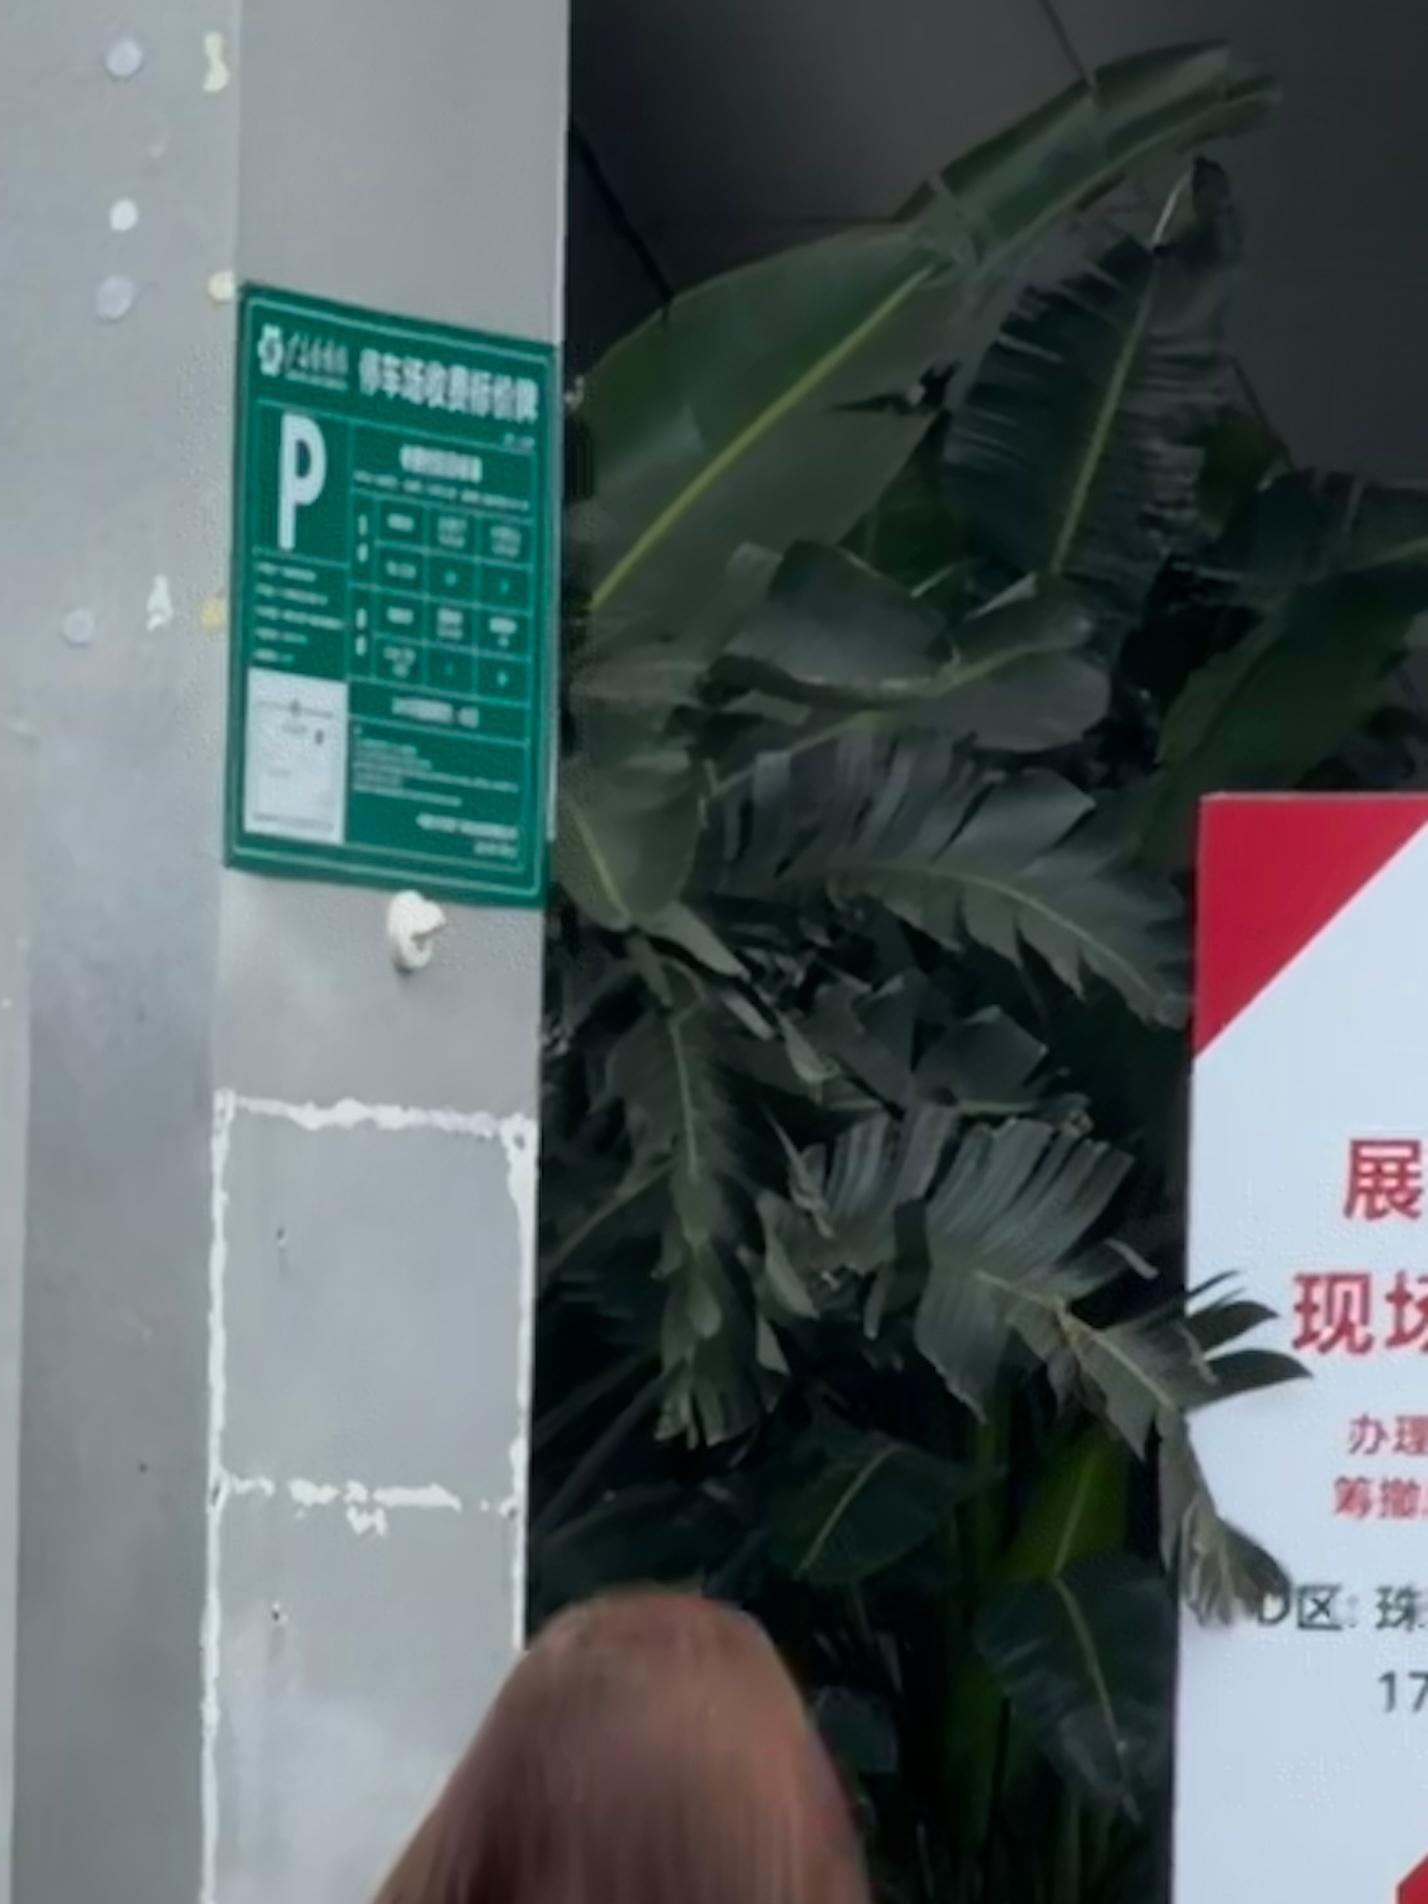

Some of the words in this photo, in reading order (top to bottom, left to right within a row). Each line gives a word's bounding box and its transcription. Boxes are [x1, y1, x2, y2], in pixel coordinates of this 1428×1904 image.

[278, 412, 327, 551] P
[1344, 1139, 1423, 1220] 展
[1334, 1475, 1428, 1519] 筹撤
